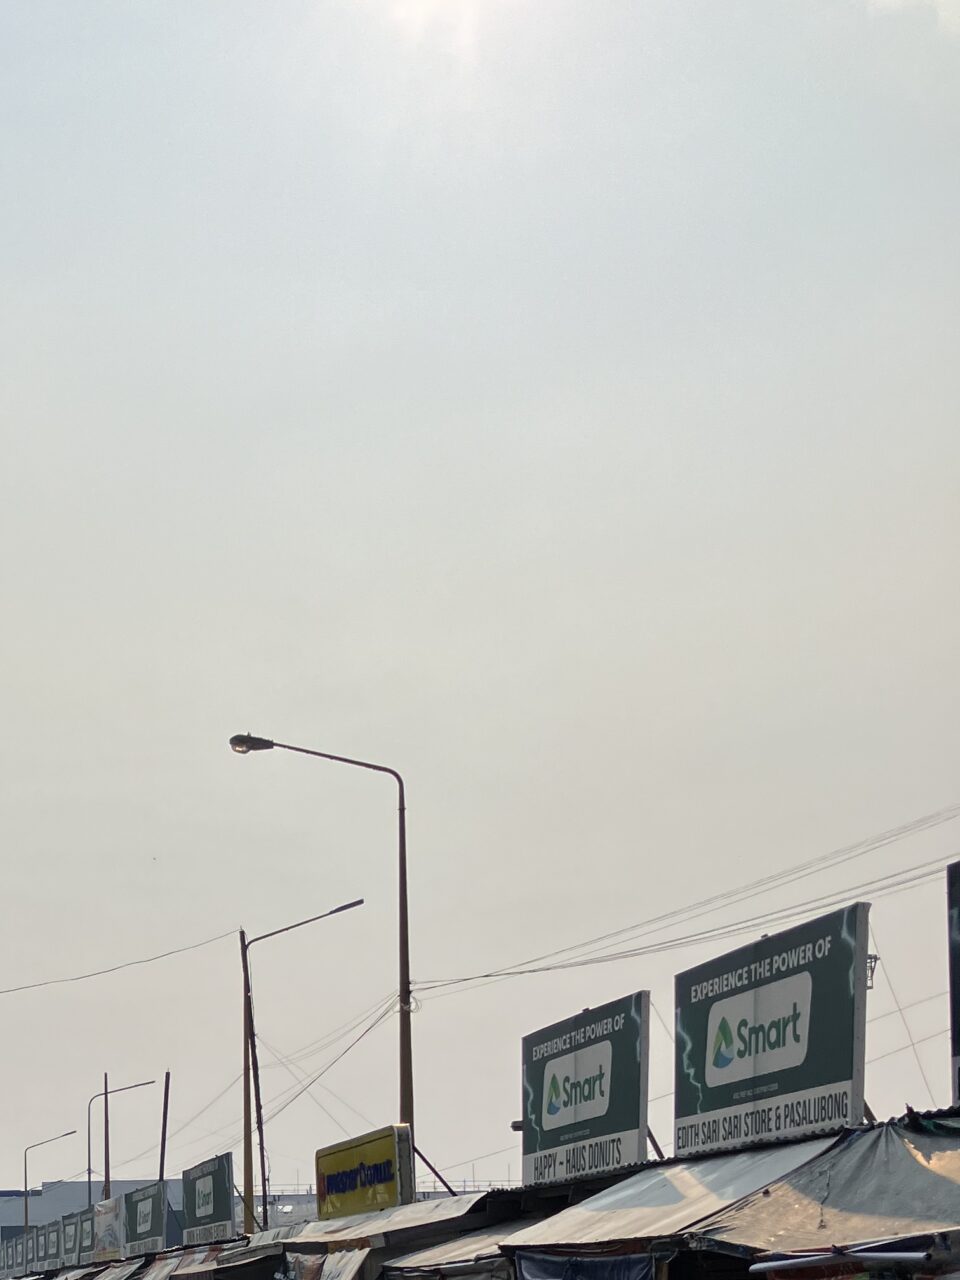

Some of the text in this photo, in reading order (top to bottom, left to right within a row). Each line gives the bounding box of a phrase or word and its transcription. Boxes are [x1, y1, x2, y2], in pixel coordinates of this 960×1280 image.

[691, 936, 832, 1003] EXPERIENCE THE POWER OF
[532, 1013, 625, 1062] EXPERIENCE THE POWER OF
[736, 1002, 801, 1059] Smart
[562, 1064, 605, 1108] Smart
[677, 1091, 849, 1150] EDITH SARI SARI STORE & PASALUBONG
[534, 1152, 558, 1181] HAPPY
[566, 1145, 587, 1175] HAUS
[589, 1137, 622, 1169] DONUTS
